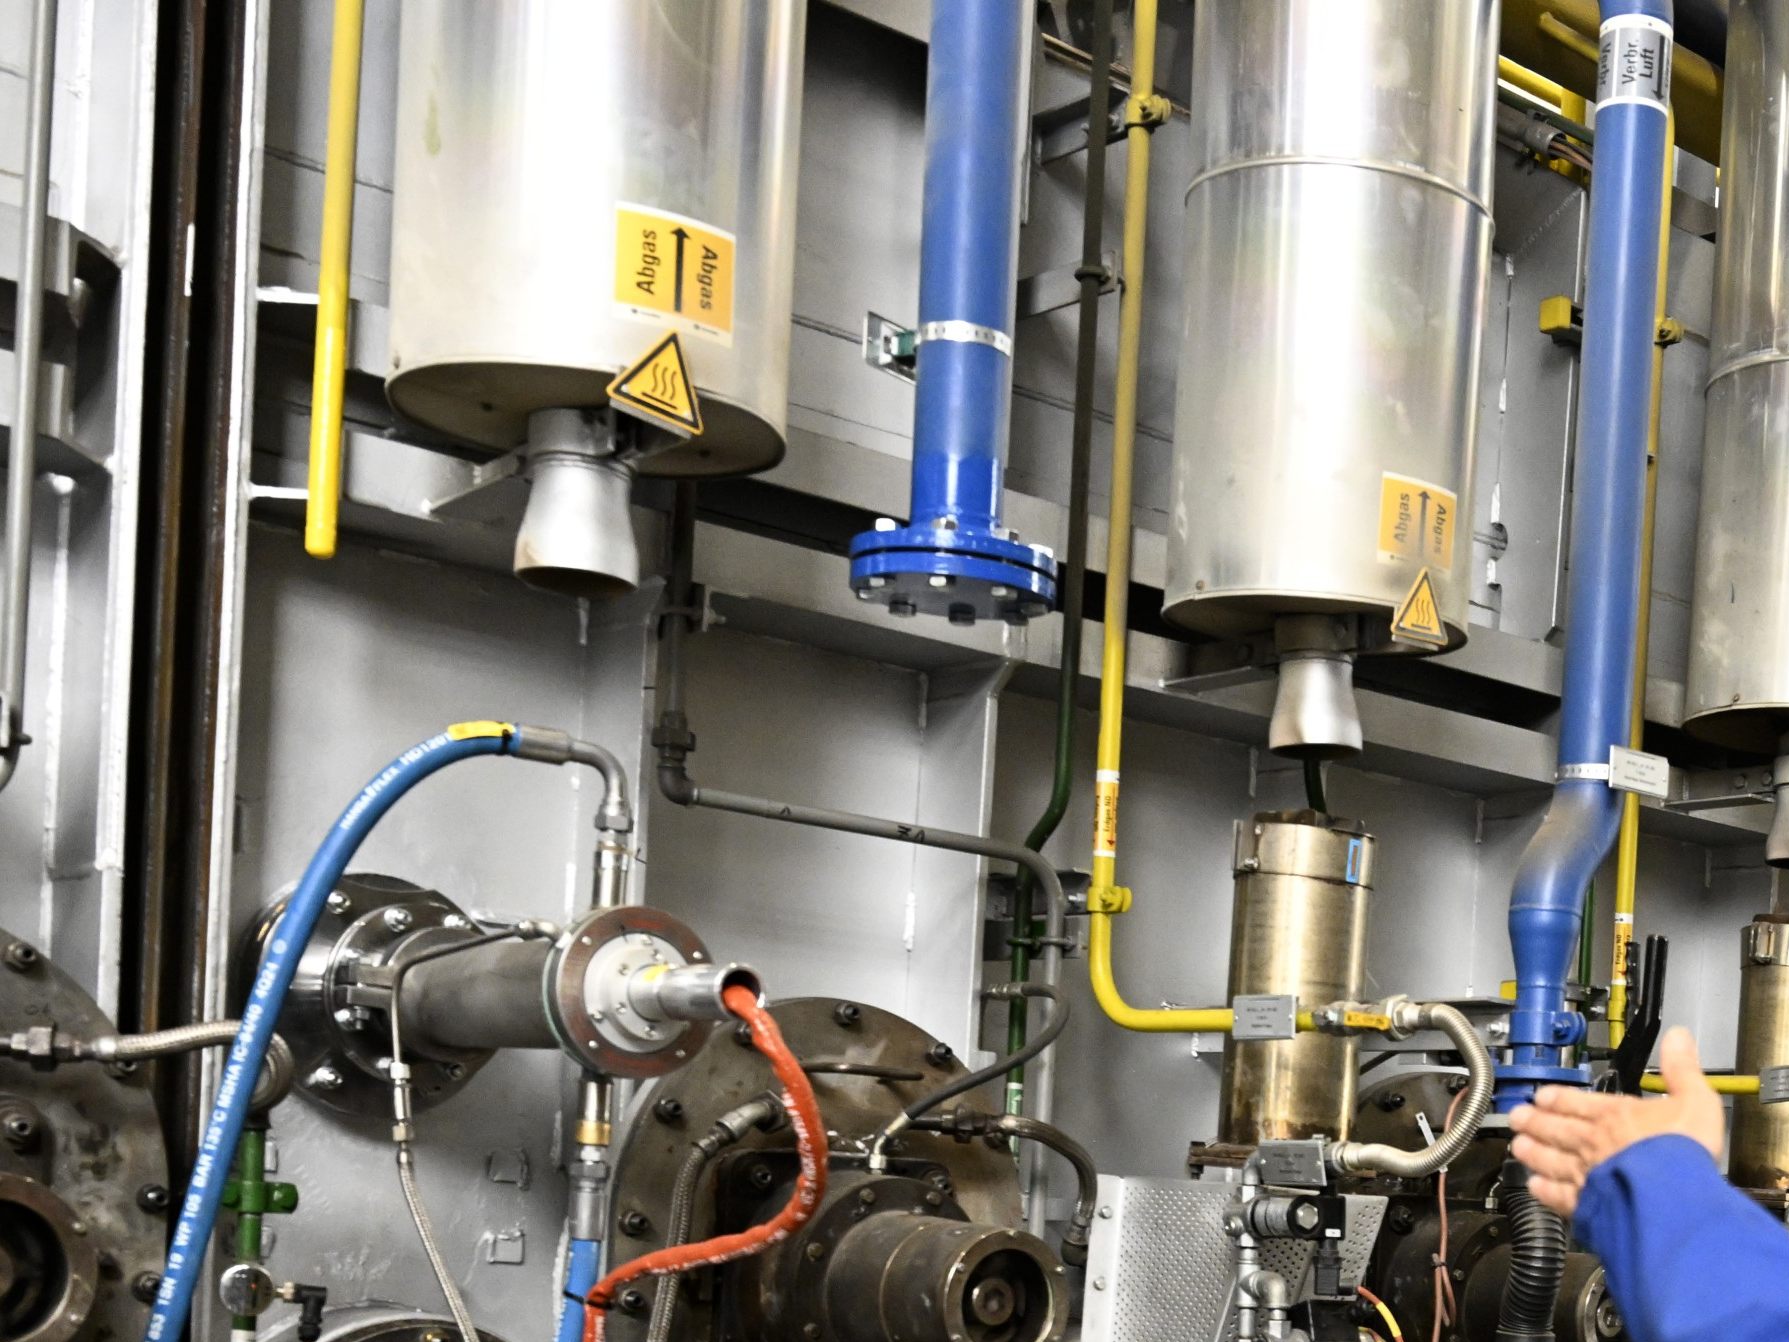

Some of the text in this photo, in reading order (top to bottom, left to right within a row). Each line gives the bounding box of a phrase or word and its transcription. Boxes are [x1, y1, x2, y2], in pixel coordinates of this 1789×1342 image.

[1621, 39, 1639, 85] Verbr.
[1638, 48, 1654, 79] Luft
[635, 229, 661, 296] Abgas
[696, 243, 718, 311] Abgas
[1393, 492, 1412, 544] Abgas
[1432, 503, 1447, 555] Abgas
[191, 1150, 215, 1189] BAR
